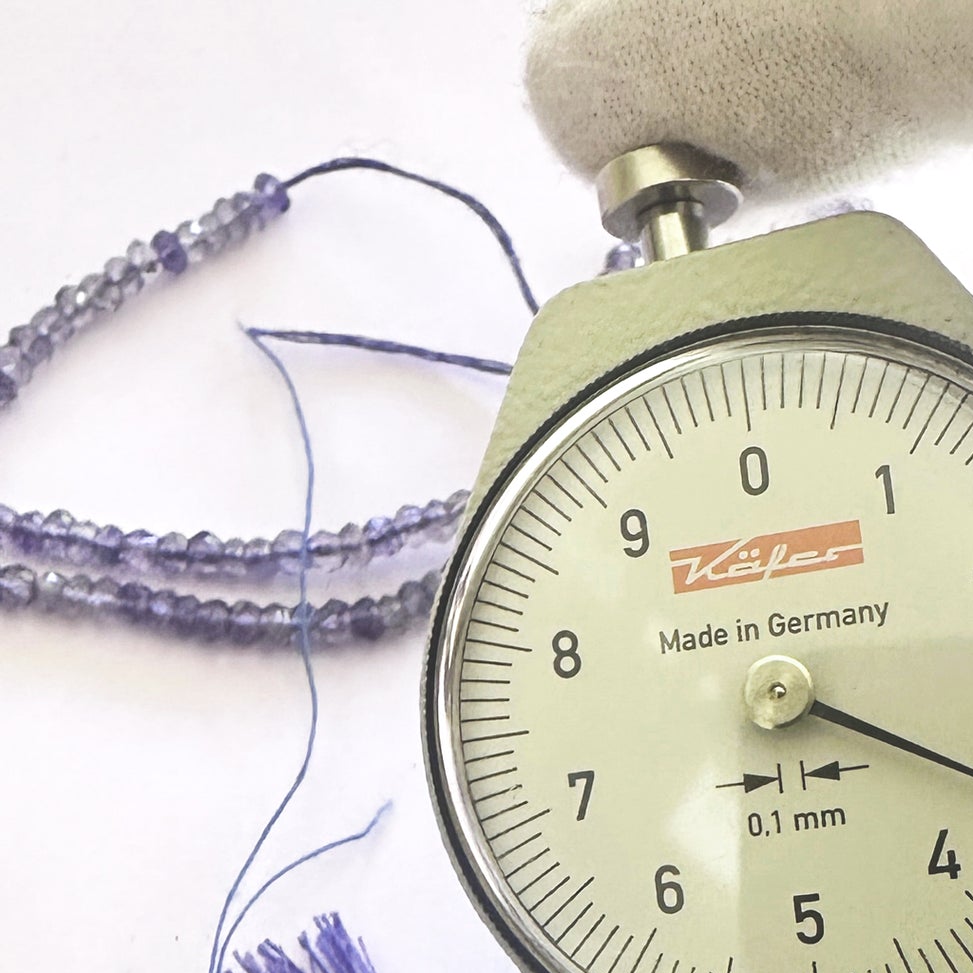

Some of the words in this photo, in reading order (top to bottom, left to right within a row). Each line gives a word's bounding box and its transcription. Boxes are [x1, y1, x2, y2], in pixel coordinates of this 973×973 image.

[739, 446, 770, 497] 0
[874, 464, 896, 515] 1
[620, 508, 650, 559] 9
[551, 629, 582, 679] 8
[659, 623, 729, 655] Made
[735, 618, 760, 643] in
[768, 602, 889, 637] Germany
[567, 770, 595, 822] 7
[747, 809, 781, 837] 0,1
[793, 807, 846, 832] mm
[927, 828, 962, 880] 4
[654, 864, 685, 915] 6
[792, 892, 825, 945] 5
